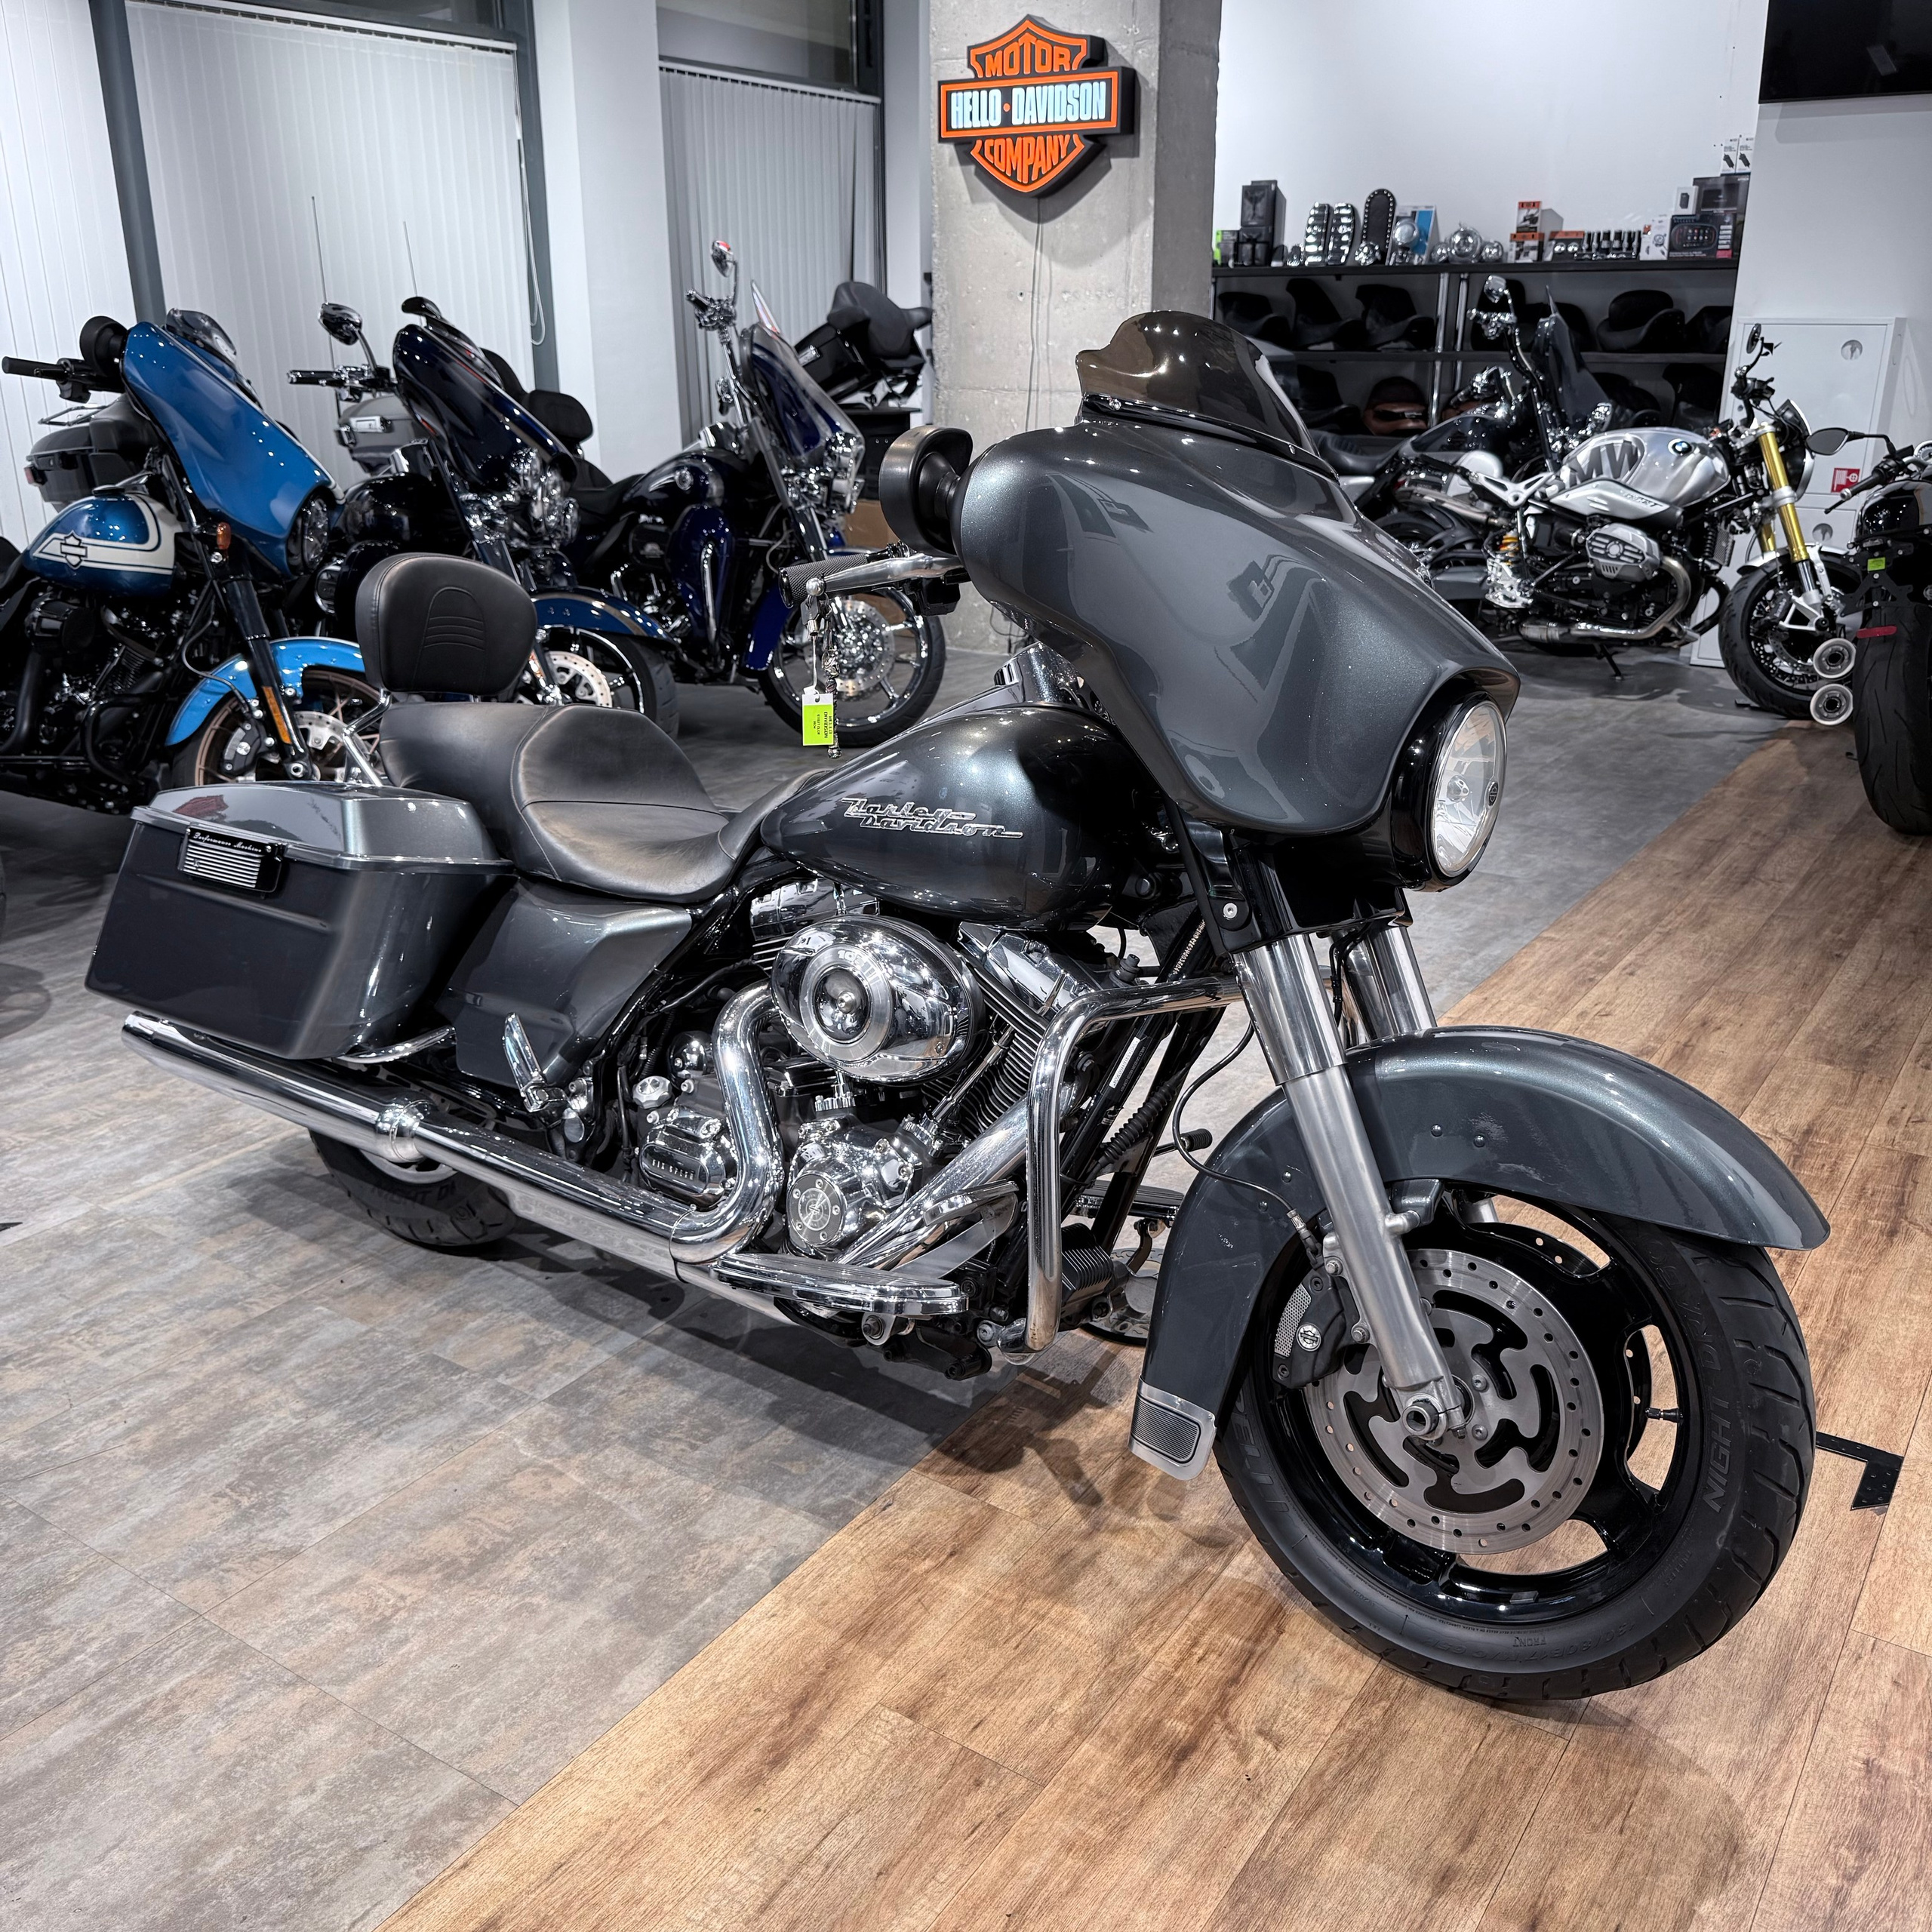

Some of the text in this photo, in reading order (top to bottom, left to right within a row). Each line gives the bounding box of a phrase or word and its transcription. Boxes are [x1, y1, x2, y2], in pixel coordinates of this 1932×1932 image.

[985, 32, 1071, 78] MOTOR
[951, 81, 1106, 129] HELLO DAVIDSON
[984, 134, 1070, 184] COMPANY
[1568, 439, 1638, 488] MW
[1702, 1386, 1732, 1513] NIGHT
[1512, 1635, 1546, 1647] FRONT
